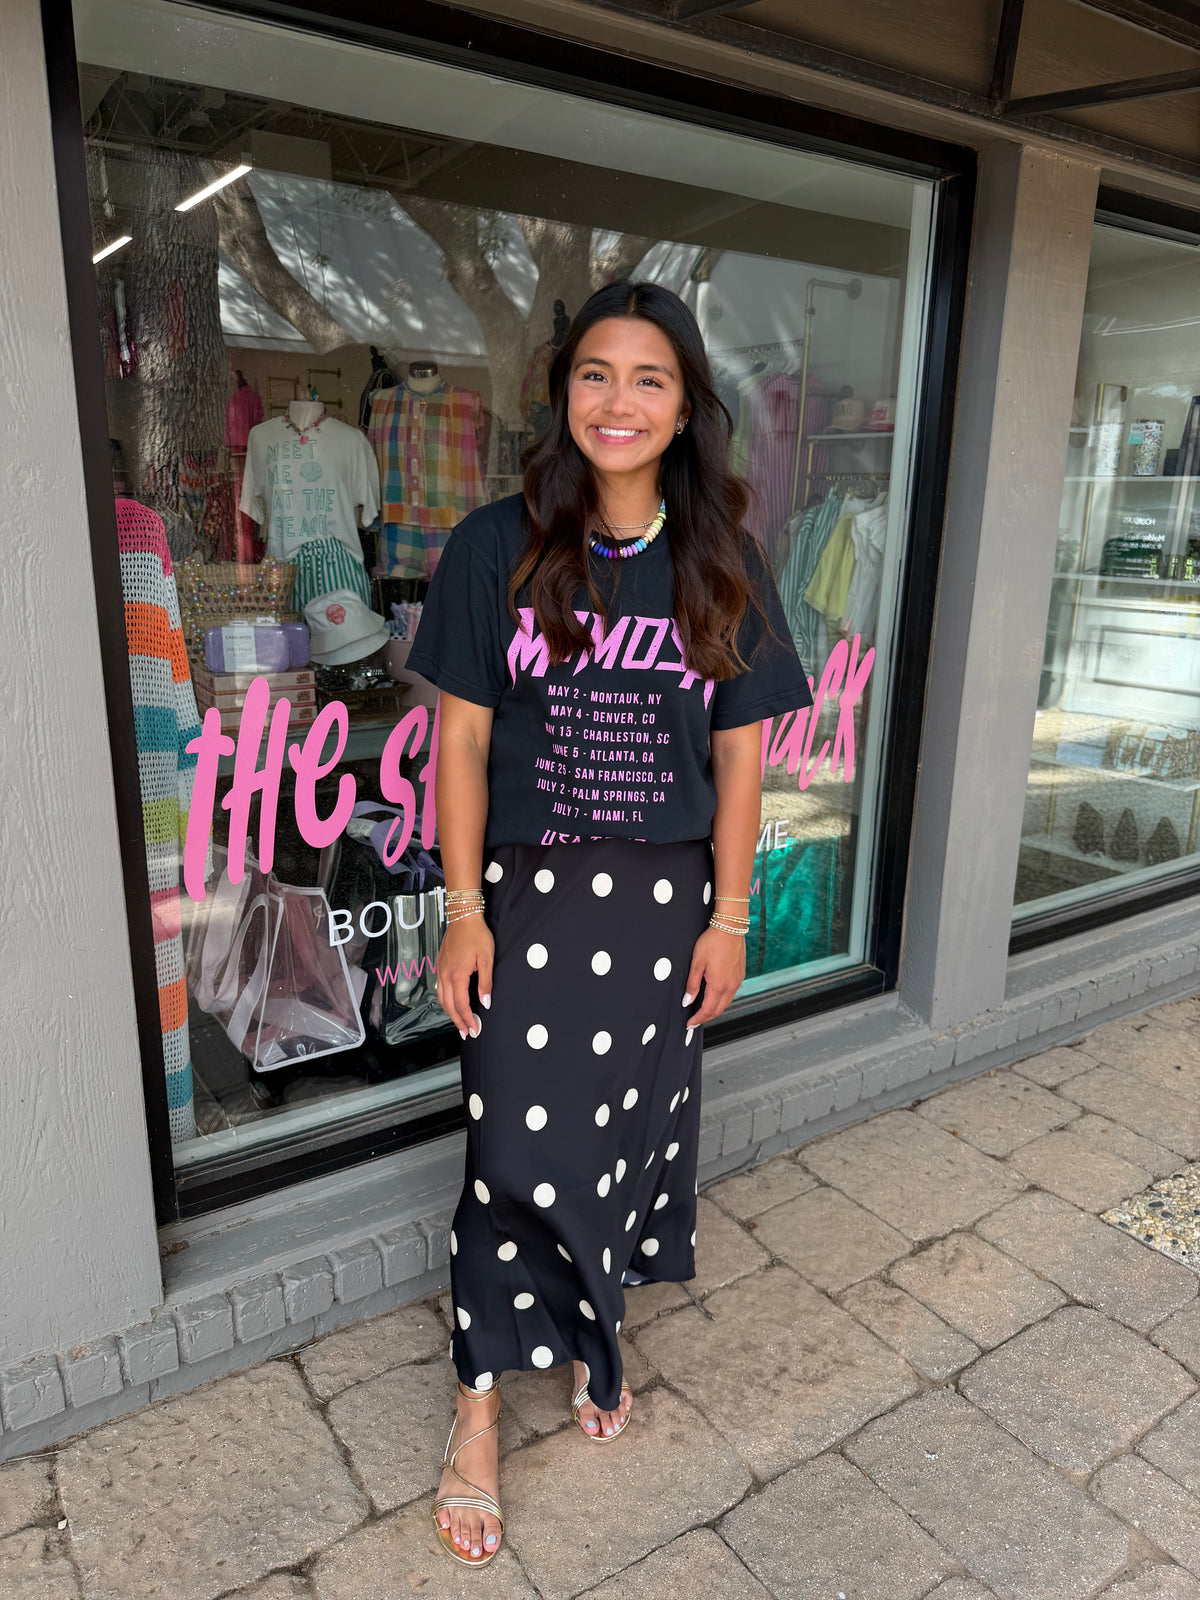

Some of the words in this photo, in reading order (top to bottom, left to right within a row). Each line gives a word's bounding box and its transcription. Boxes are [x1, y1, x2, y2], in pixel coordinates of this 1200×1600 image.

[267, 439, 318, 465] MEET
[267, 463, 293, 485] ME
[272, 489, 294, 510] AT
[302, 487, 336, 512] THE
[547, 684, 570, 697] MAY
[573, 688, 580, 699] 2
[590, 691, 643, 705] MONTAUK,
[648, 693, 662, 705] NY
[550, 705, 573, 717] MAY
[576, 708, 582, 719] 4
[593, 710, 637, 725] DENVER,
[642, 713, 656, 724] CO
[560, 726, 572, 737] 15
[583, 729, 652, 744] CHARLESTON,
[656, 733, 670, 744] SC
[572, 747, 579, 758] 5
[590, 749, 638, 763] ATLANTA,
[642, 752, 655, 763] GA
[535, 757, 556, 772] JUNE
[558, 763, 567, 775] 25
[574, 767, 595, 780] SAN
[598, 770, 657, 784] FRANCISCO,
[661, 771, 674, 783] CA
[536, 778, 557, 792] JULY
[560, 783, 565, 795] 2
[572, 787, 600, 801] PALM
[603, 790, 648, 803] SPRINGS,
[653, 791, 665, 803] CA
[552, 802, 572, 817] JULY
[574, 807, 579, 818] 7
[592, 809, 628, 822] MIAMI,
[632, 811, 644, 822] FL
